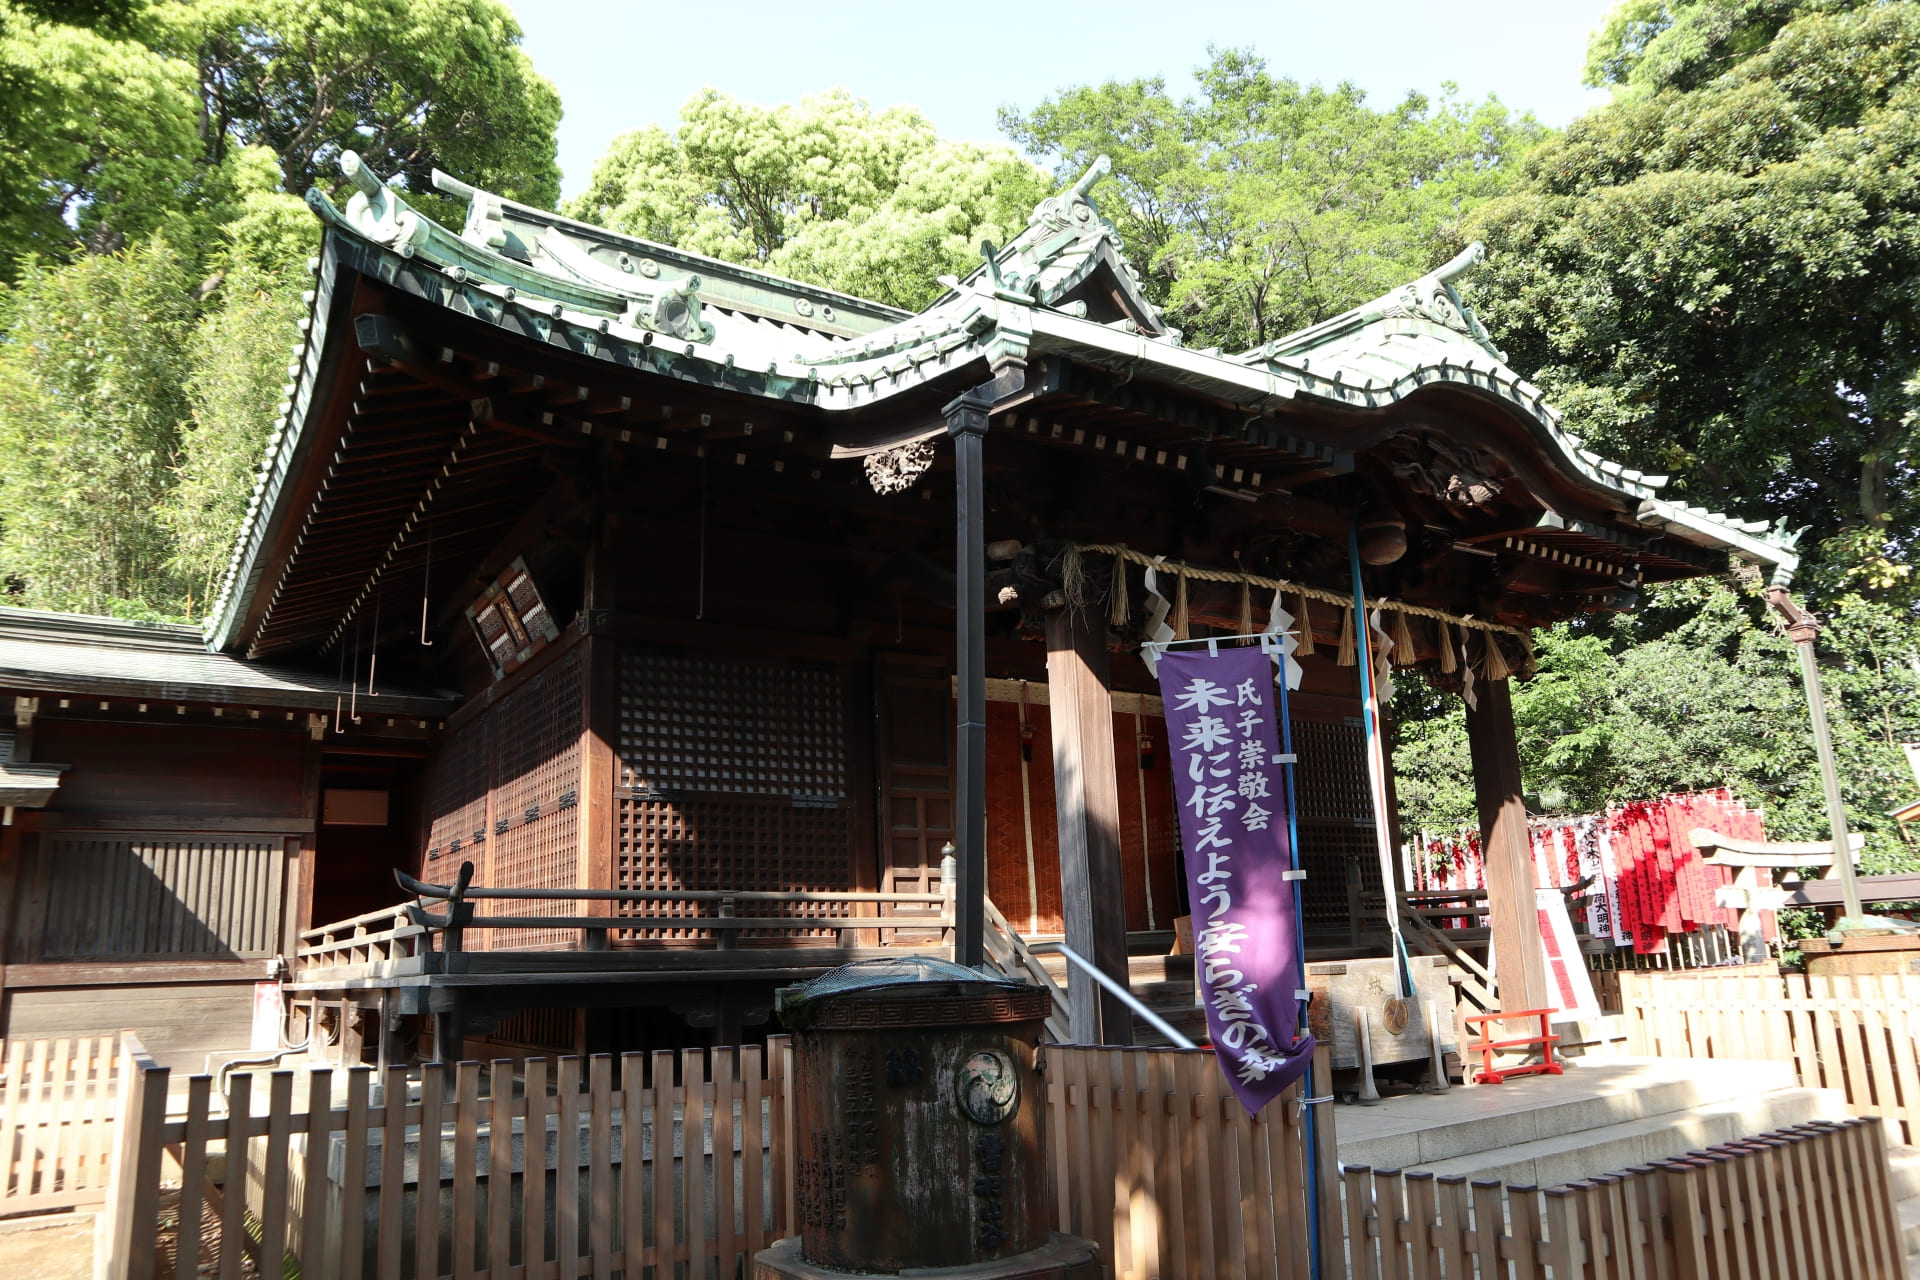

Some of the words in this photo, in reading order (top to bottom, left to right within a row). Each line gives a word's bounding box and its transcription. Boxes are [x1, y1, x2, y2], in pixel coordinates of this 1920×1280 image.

[1236, 678, 1272, 832] 氏子崇敬会
[1174, 678, 1287, 1086] 未来に伝えよう安らぎの森
[1584, 828, 1610, 934] 代々木出世荷大明神
